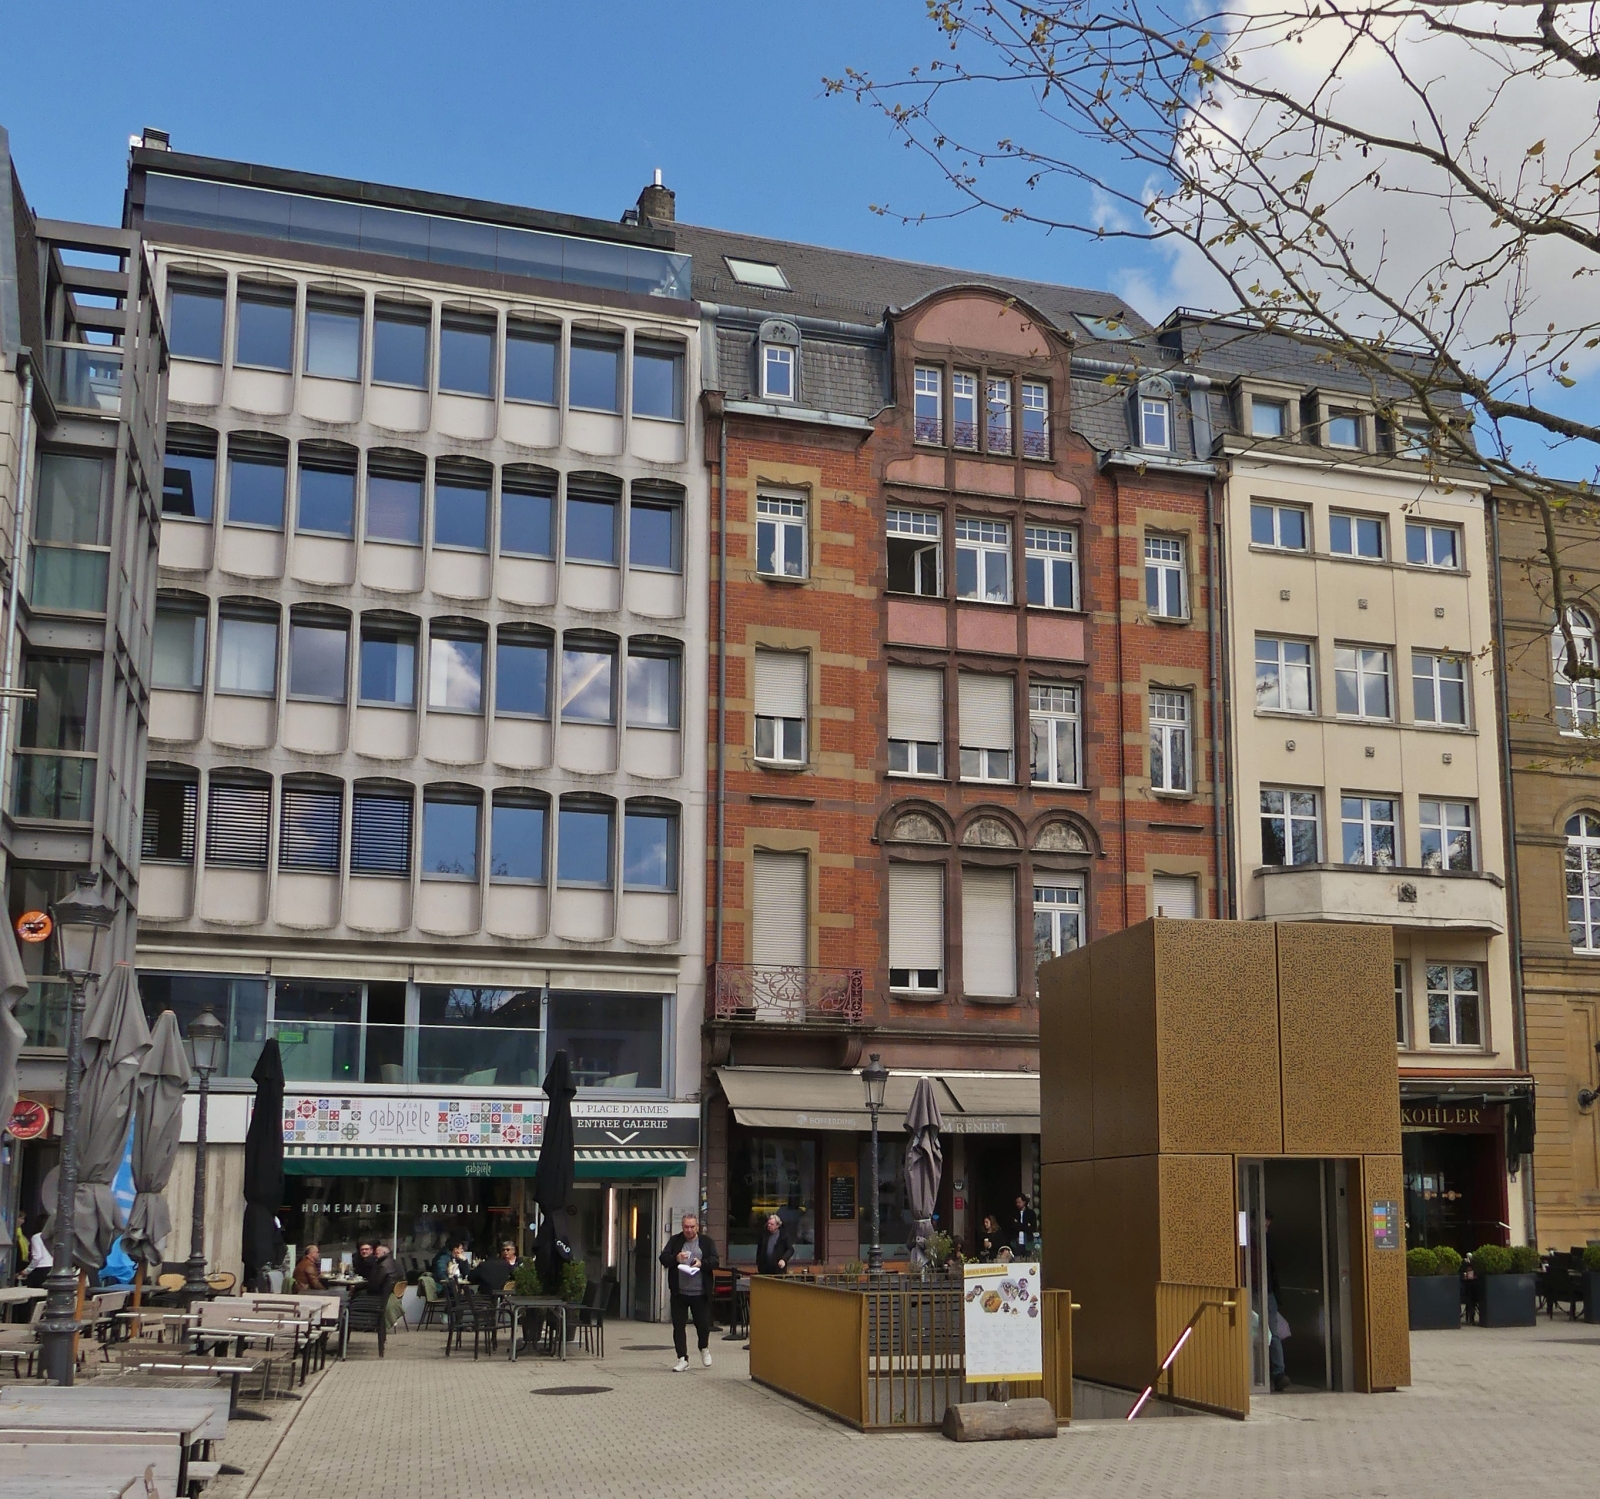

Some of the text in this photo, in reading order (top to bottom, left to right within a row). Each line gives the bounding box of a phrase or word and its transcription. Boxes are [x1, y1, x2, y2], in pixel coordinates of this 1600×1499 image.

[587, 1104, 620, 1114] PLACE
[622, 1105, 669, 1114] D'ARMES
[1401, 1108, 1481, 1123] KOHLER
[577, 1119, 668, 1129] ENTREE GALERIE
[809, 1117, 856, 1125] BOFFERDING
[956, 1122, 1007, 1133] RENERT
[302, 1203, 479, 1213] HOMEMADE RAVIOLI
